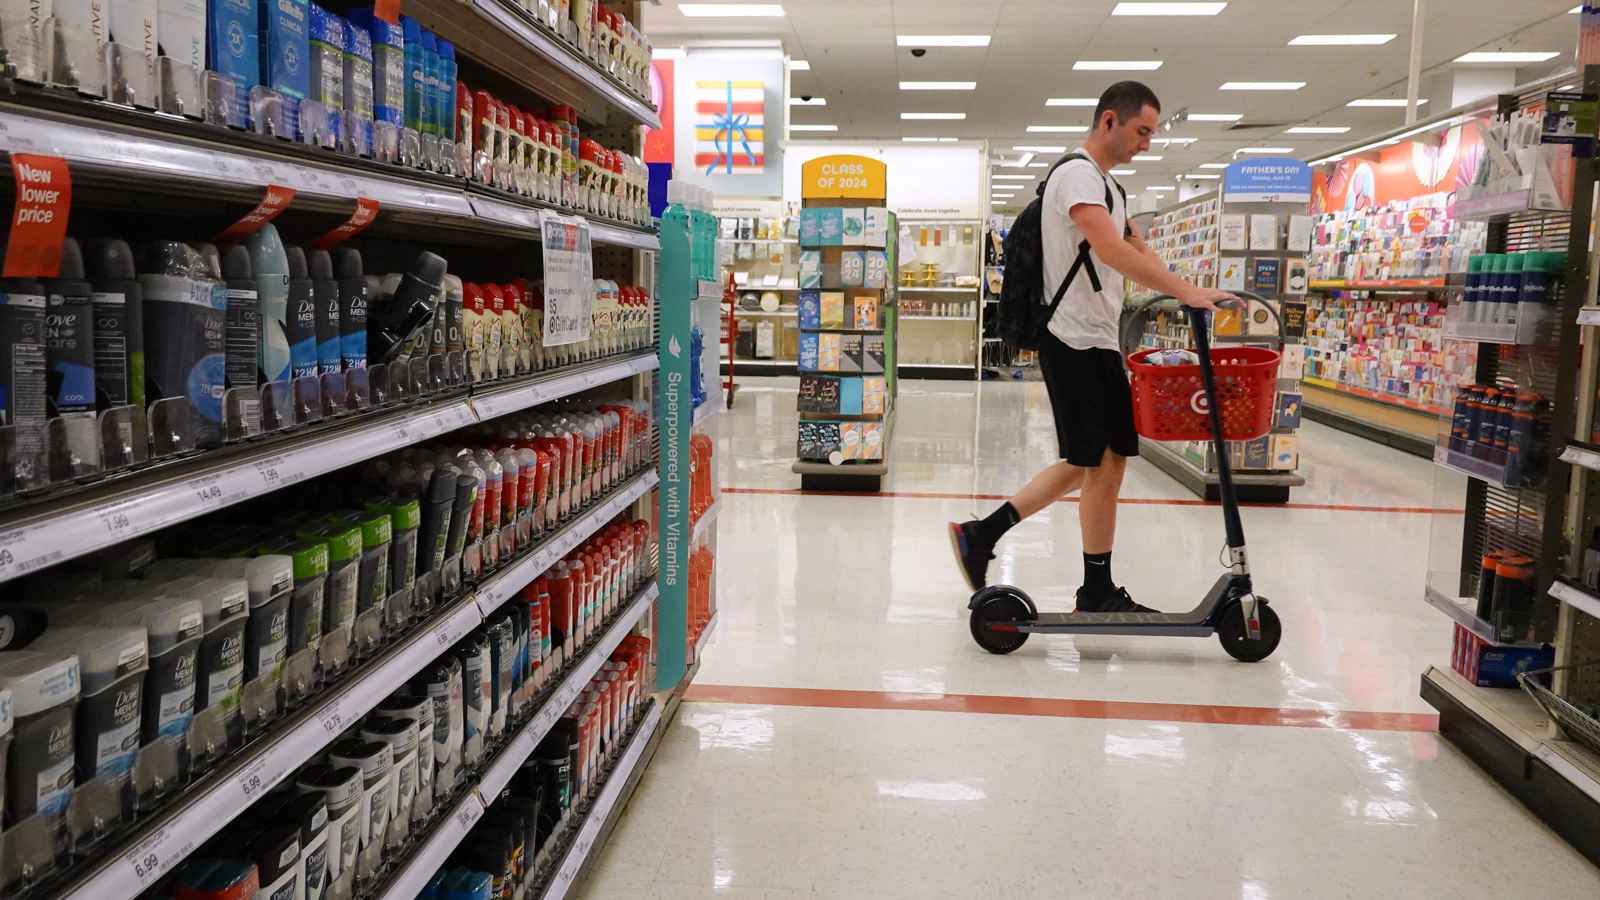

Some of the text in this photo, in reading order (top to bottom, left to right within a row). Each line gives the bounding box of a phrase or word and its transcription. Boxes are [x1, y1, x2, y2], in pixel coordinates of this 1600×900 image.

[17, 163, 52, 183] New
[821, 163, 864, 175] CLASS
[1241, 166, 1300, 175] FATHER'S DAY
[817, 177, 868, 188] OF 2024
[21, 183, 60, 204] lower
[16, 205, 54, 226] price
[259, 468, 280, 482] 7.99
[665, 371, 682, 586] Superpowered with Vitamins
[198, 484, 223, 502] 14.49
[103, 513, 130, 531] 7.99
[242, 775, 262, 795] 6.99
[134, 852, 160, 878] 6.99
